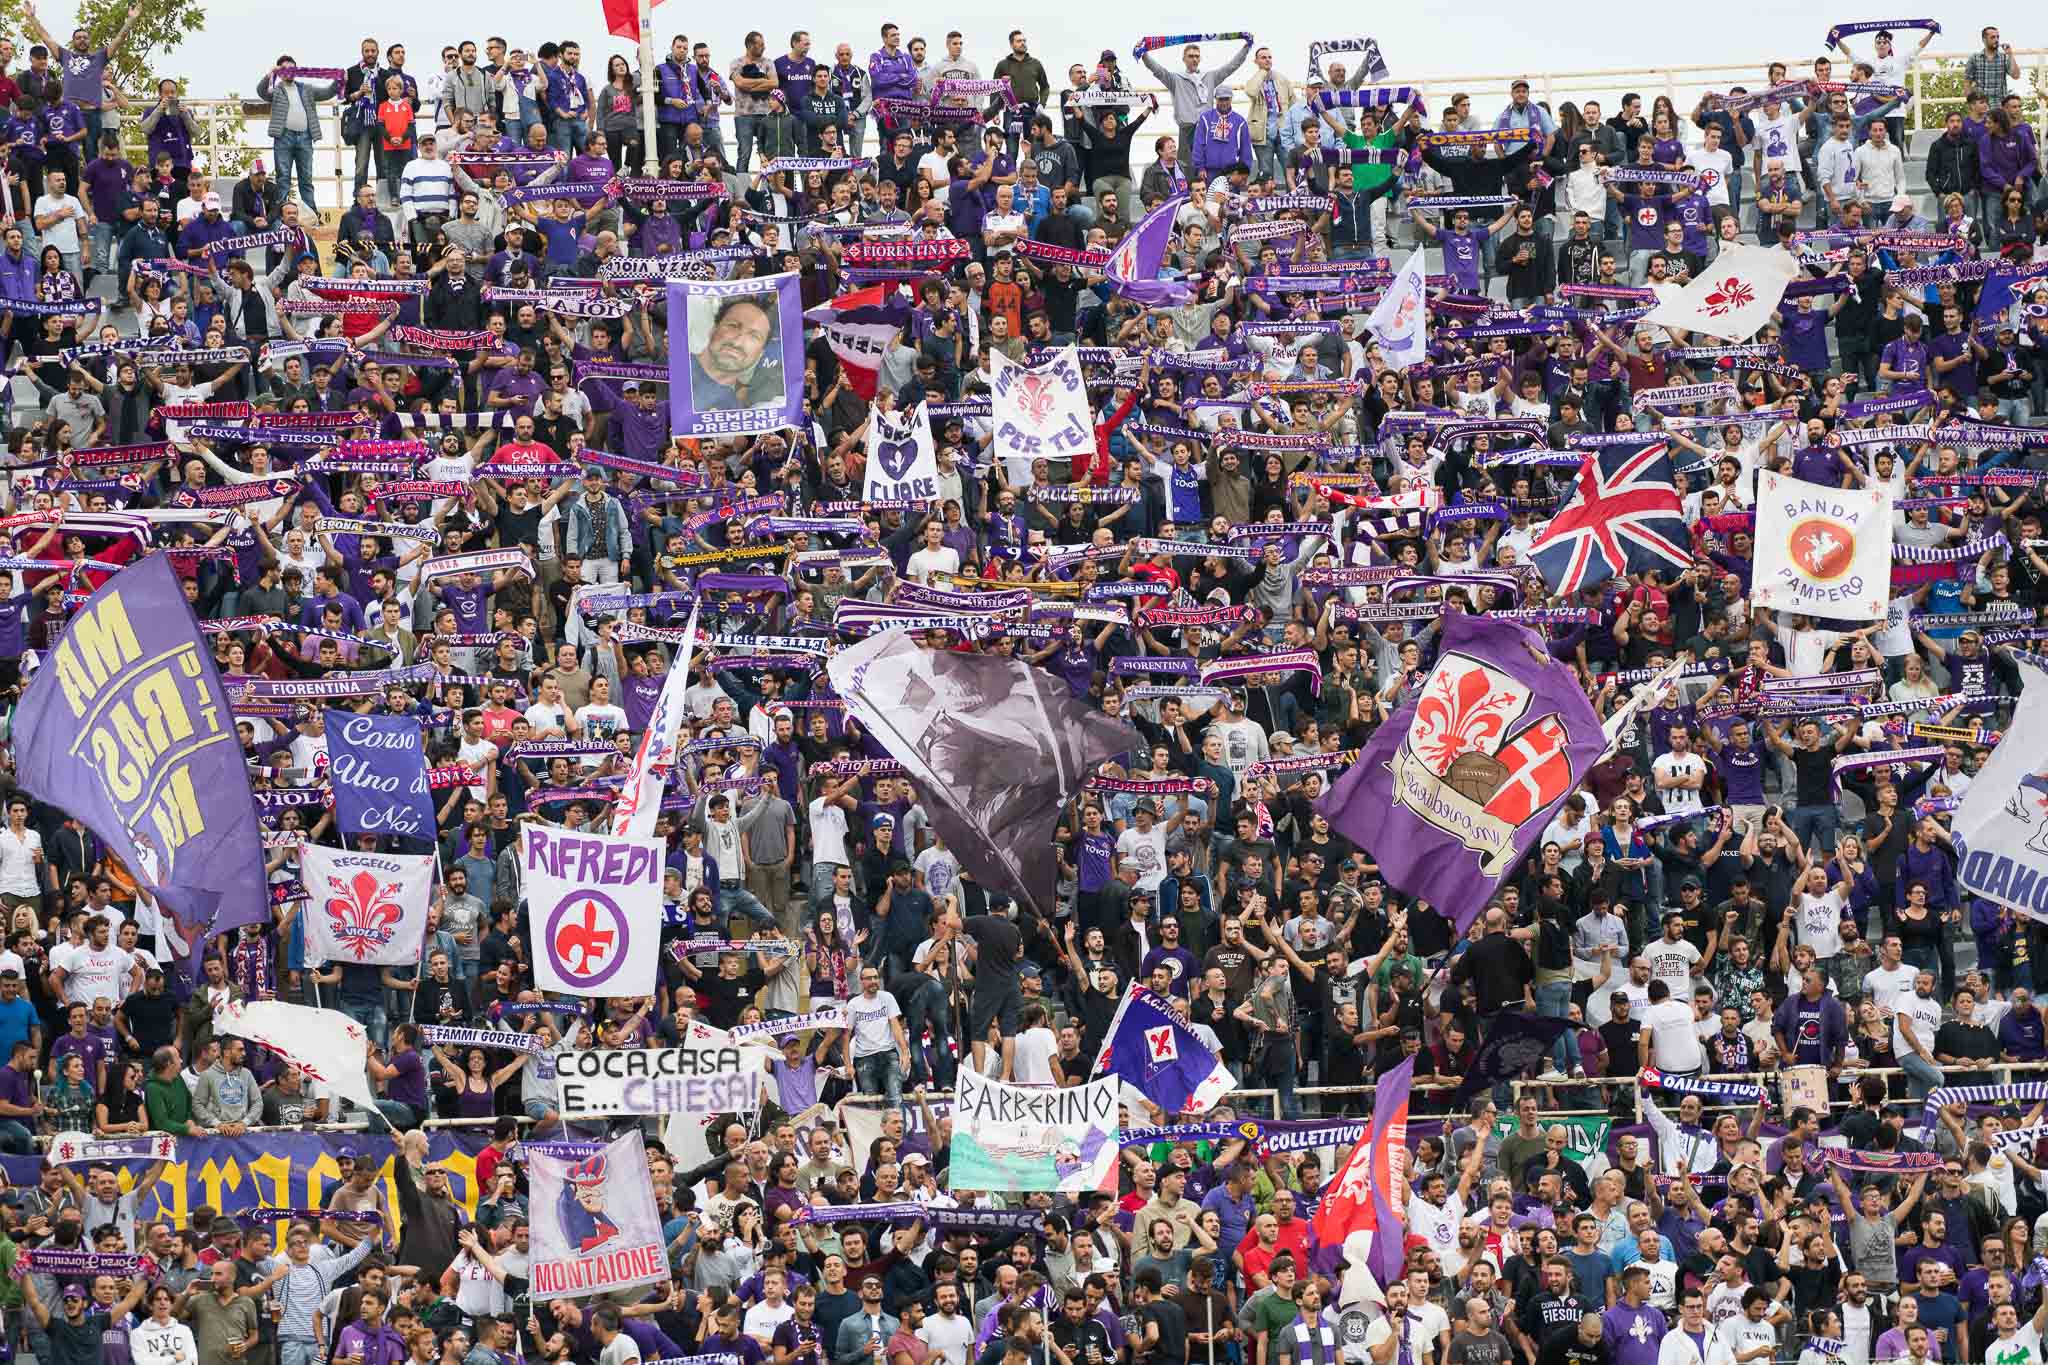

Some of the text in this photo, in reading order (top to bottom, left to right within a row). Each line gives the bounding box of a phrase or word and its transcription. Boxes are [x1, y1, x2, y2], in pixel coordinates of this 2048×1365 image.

[922, 106, 972, 118] Fiorentina
[531, 184, 596, 196] FIORENTINA
[661, 183, 709, 197] Fiorentina
[694, 246, 753, 262] FIORENTINA
[863, 245, 950, 258] FIORENTINA
[1288, 261, 1370, 272] FIORENTINA
[688, 280, 776, 297] DAVIDE
[14, 301, 87, 312] FIORENTINA
[1472, 327, 1532, 337] FIORENTINA
[261, 413, 352, 428] FIORENTINA
[701, 408, 780, 424] SEMPRE
[691, 415, 790, 435] PRESENTE
[1143, 423, 1214, 441] FIORENTINA
[190, 427, 243, 441] CURVA
[1604, 431, 1668, 444] FIORENTI
[73, 447, 166, 466] FIORENTINA
[303, 461, 337, 472] JUVE
[60, 478, 116, 490] Fiorentina
[198, 486, 269, 504] FIORENTINA
[1439, 505, 1495, 518] FIORENTINA
[1783, 498, 1859, 526] BANDA
[315, 519, 362, 533] VERONA
[1103, 583, 1169, 596] FIORENTINA
[1777, 566, 1864, 603] PAMPERO
[1359, 606, 1436, 619] FIORENTINA
[1006, 627, 1050, 638] viola club
[1122, 660, 1188, 671] FIORENTINA
[1827, 673, 1863, 686] VIOLA
[272, 682, 362, 696] FIORENTINA
[1862, 700, 1937, 716] ORENTINA
[343, 716, 416, 750] Corso
[334, 753, 401, 793] Uno
[840, 758, 904, 774] FIOENTI
[1097, 777, 1196, 793] FIORENTINA
[253, 788, 325, 805] VIOL
[360, 805, 421, 835] Noi
[332, 856, 401, 873] REGGELLO
[527, 829, 658, 885] RIFREDI
[344, 928, 379, 938] VIOLA
[436, 1025, 529, 1047] FAMMI GODERE
[623, 1071, 758, 1112] CHIESA!
[1663, 1075, 1761, 1098] COLLETTIVO
[959, 1075, 1113, 1125] BARBERINO
[1118, 1122, 1234, 1146] GENERALE
[1269, 1124, 1366, 1153] COLLETTIVO
[36, 1254, 139, 1271] Forza Fiorentina
[534, 1245, 664, 1293] MONTAIONE
[147, 1334, 184, 1351] NYC
